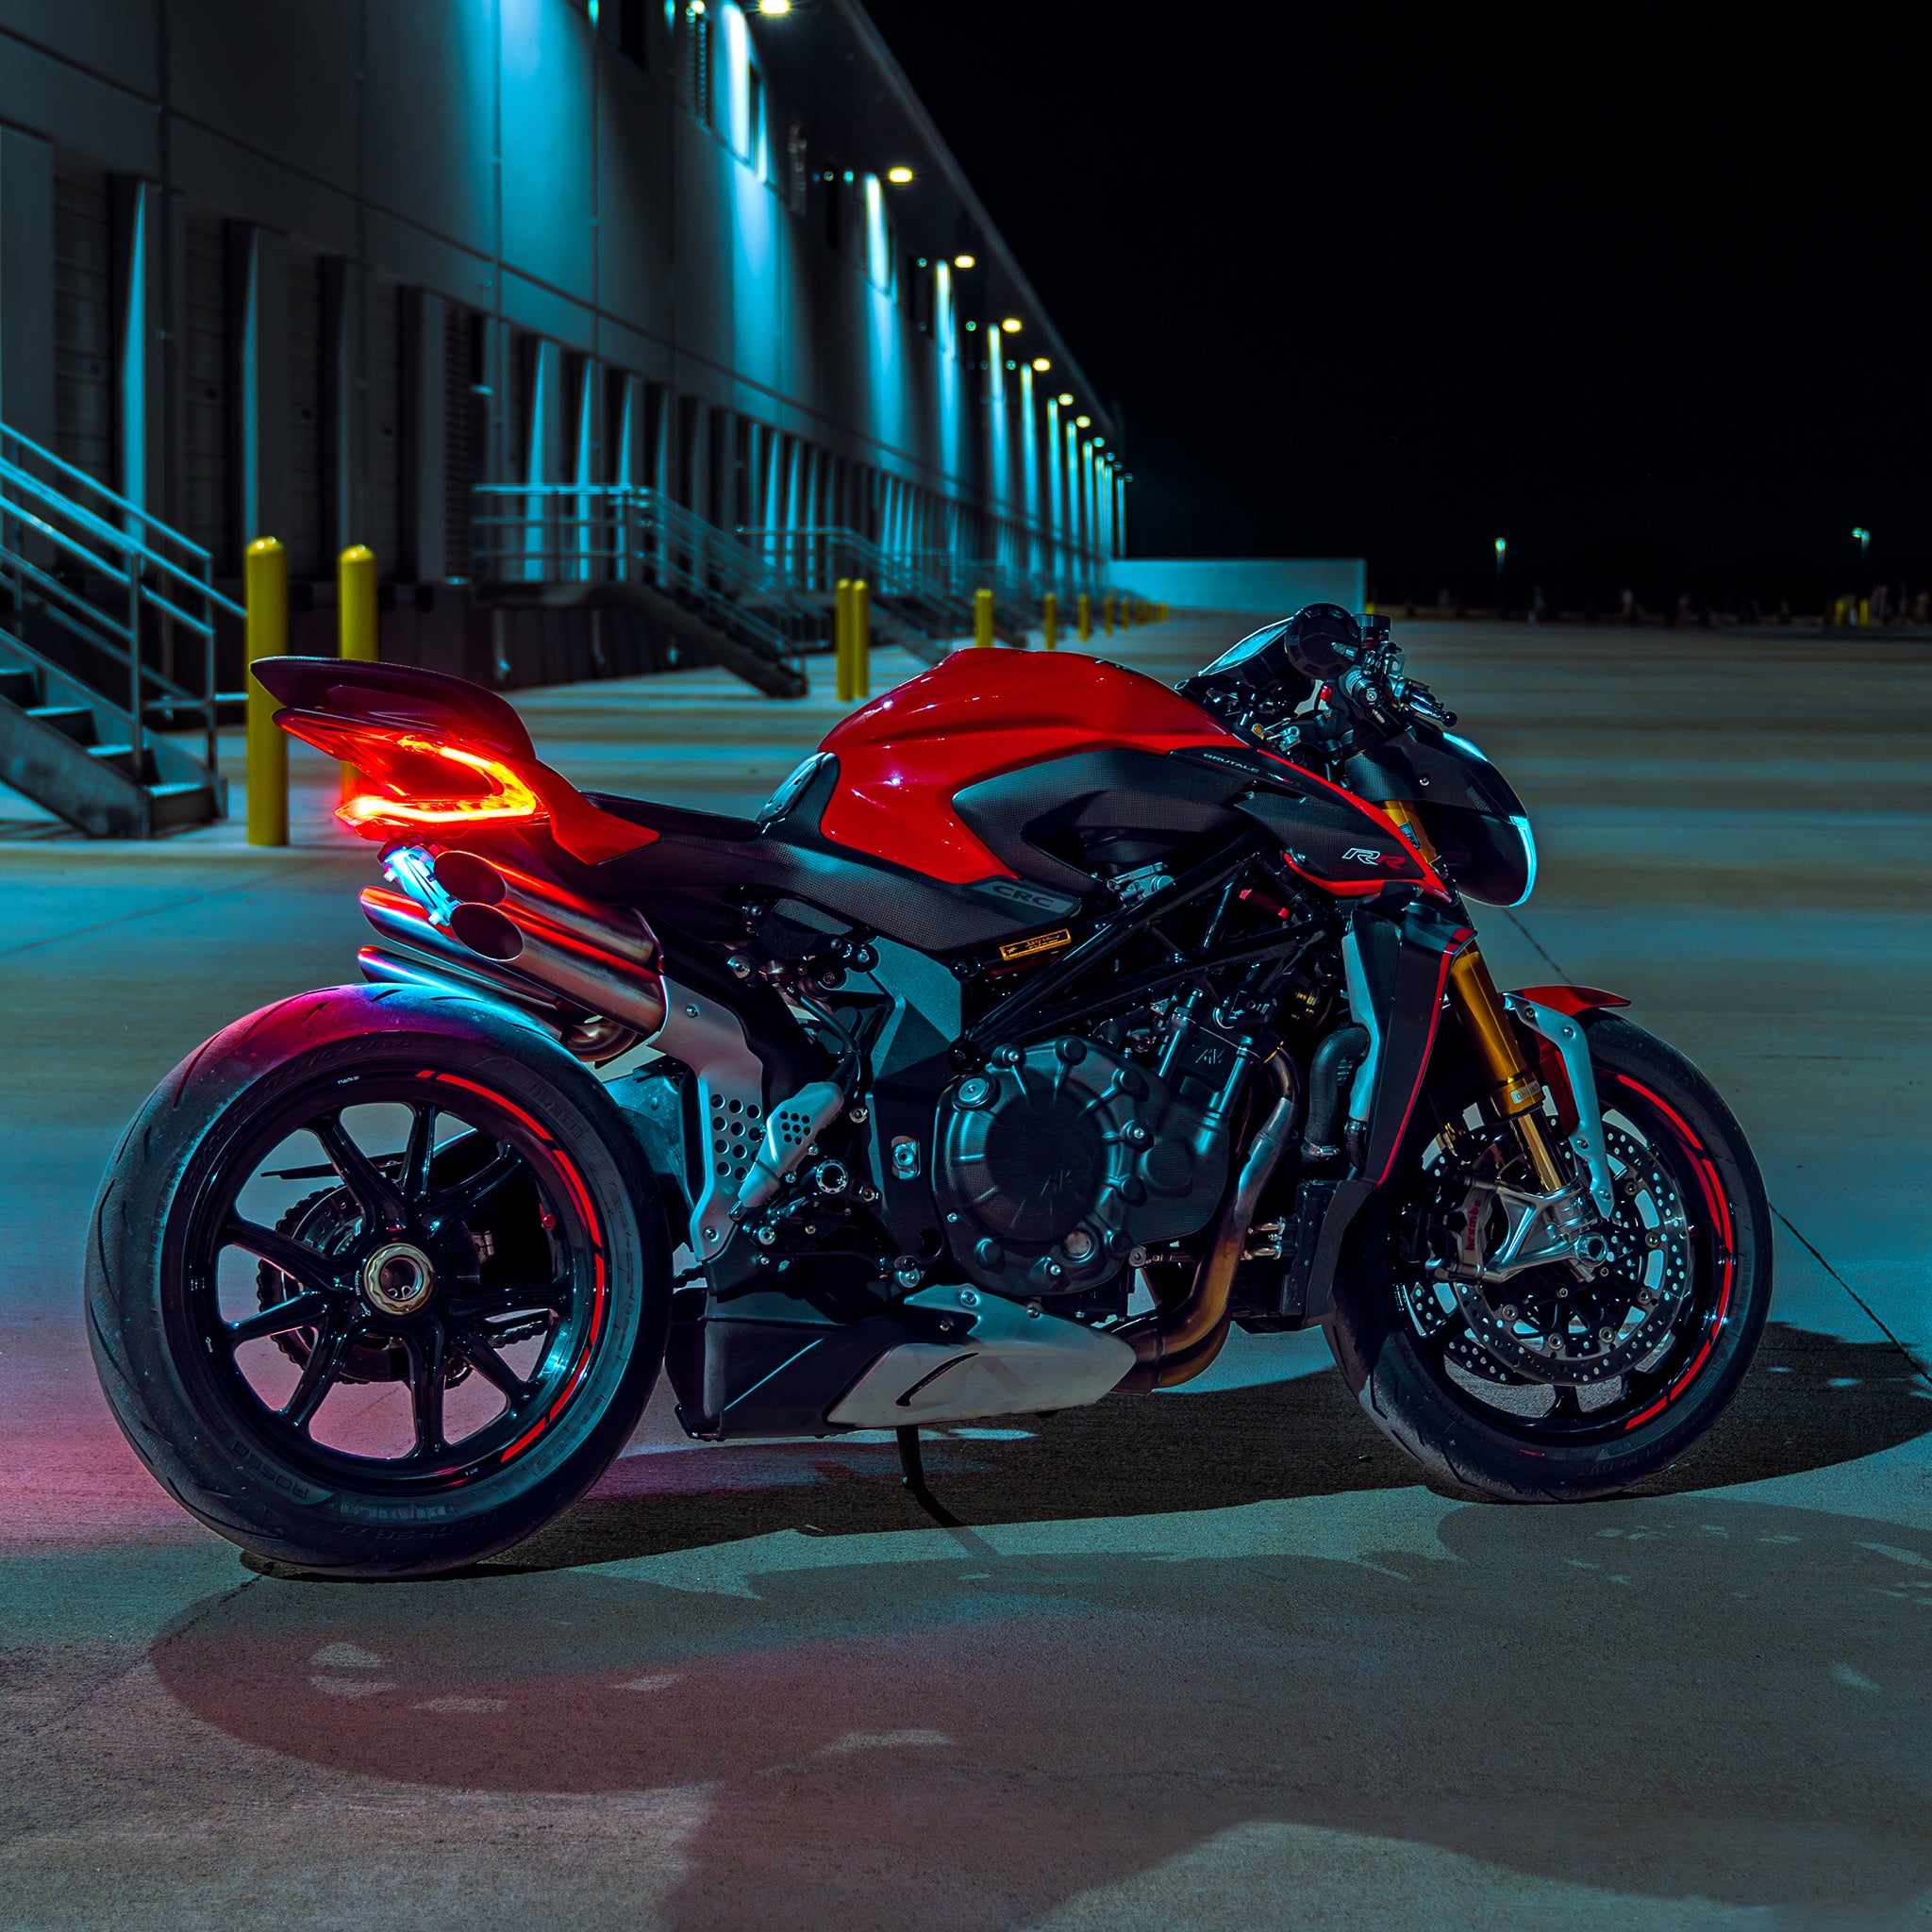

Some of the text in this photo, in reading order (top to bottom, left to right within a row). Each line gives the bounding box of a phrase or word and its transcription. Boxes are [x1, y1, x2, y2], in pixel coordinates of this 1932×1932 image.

[1203, 753, 1259, 773] BRUTALE
[1341, 847, 1407, 871] RR
[993, 886, 1055, 908] CRC
